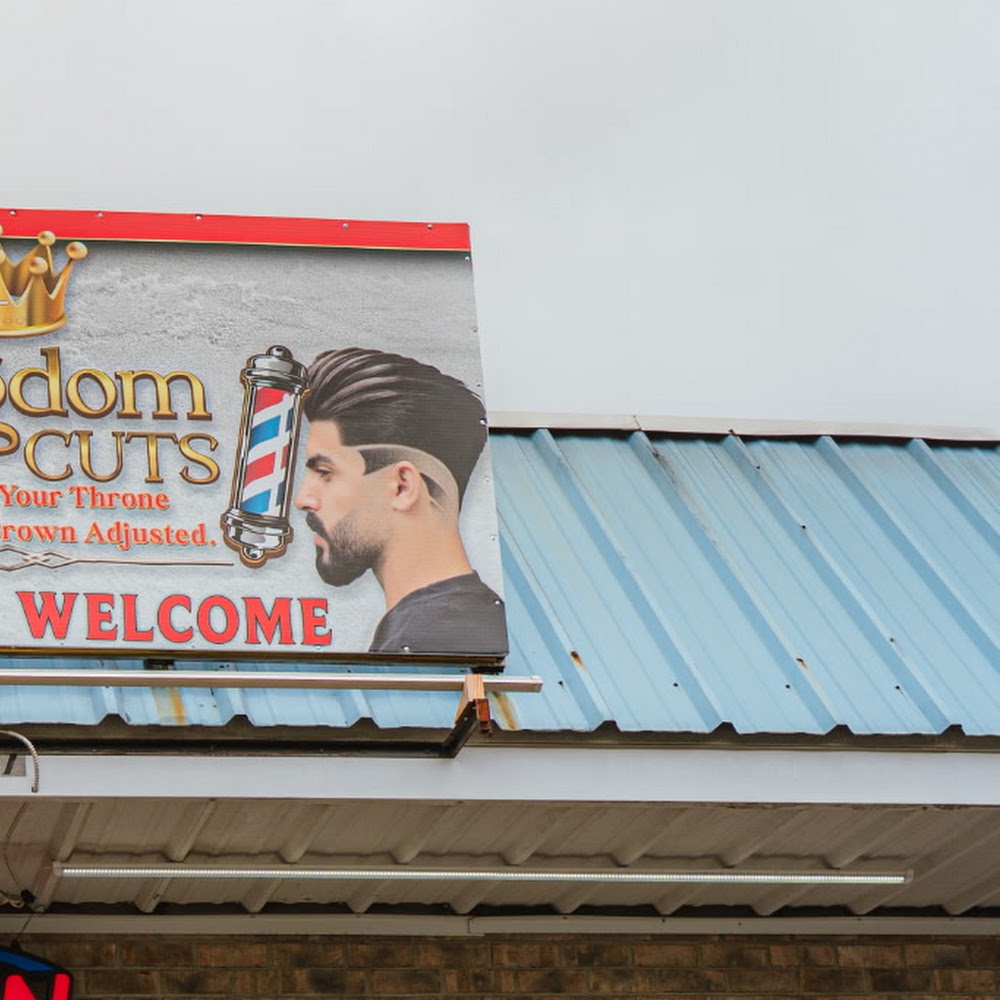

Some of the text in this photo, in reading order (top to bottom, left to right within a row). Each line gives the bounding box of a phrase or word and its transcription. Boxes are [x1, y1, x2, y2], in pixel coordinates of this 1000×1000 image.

[23, 430, 221, 485] CUTS
[62, 485, 171, 511] Throne
[83, 521, 218, 551] Adjusted.
[15, 590, 333, 646] WELCOME
